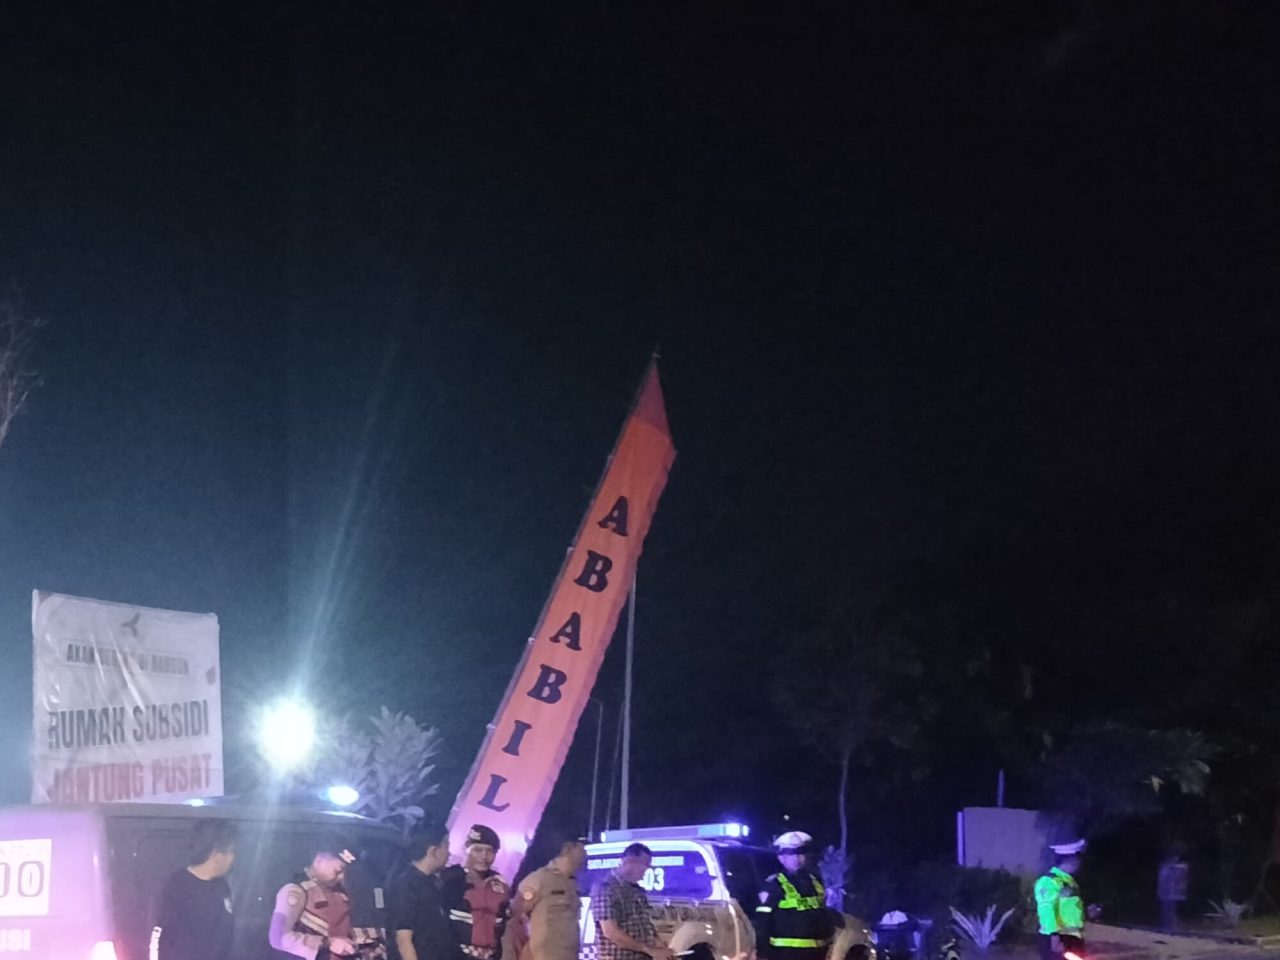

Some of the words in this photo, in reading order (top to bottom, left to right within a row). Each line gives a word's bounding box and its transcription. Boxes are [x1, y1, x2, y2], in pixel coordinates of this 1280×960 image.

[477, 495, 629, 813] ABABIL
[48, 706, 125, 750] RUMAH
[133, 699, 209, 742] SUBSIDI
[152, 753, 212, 796] PUSAT
